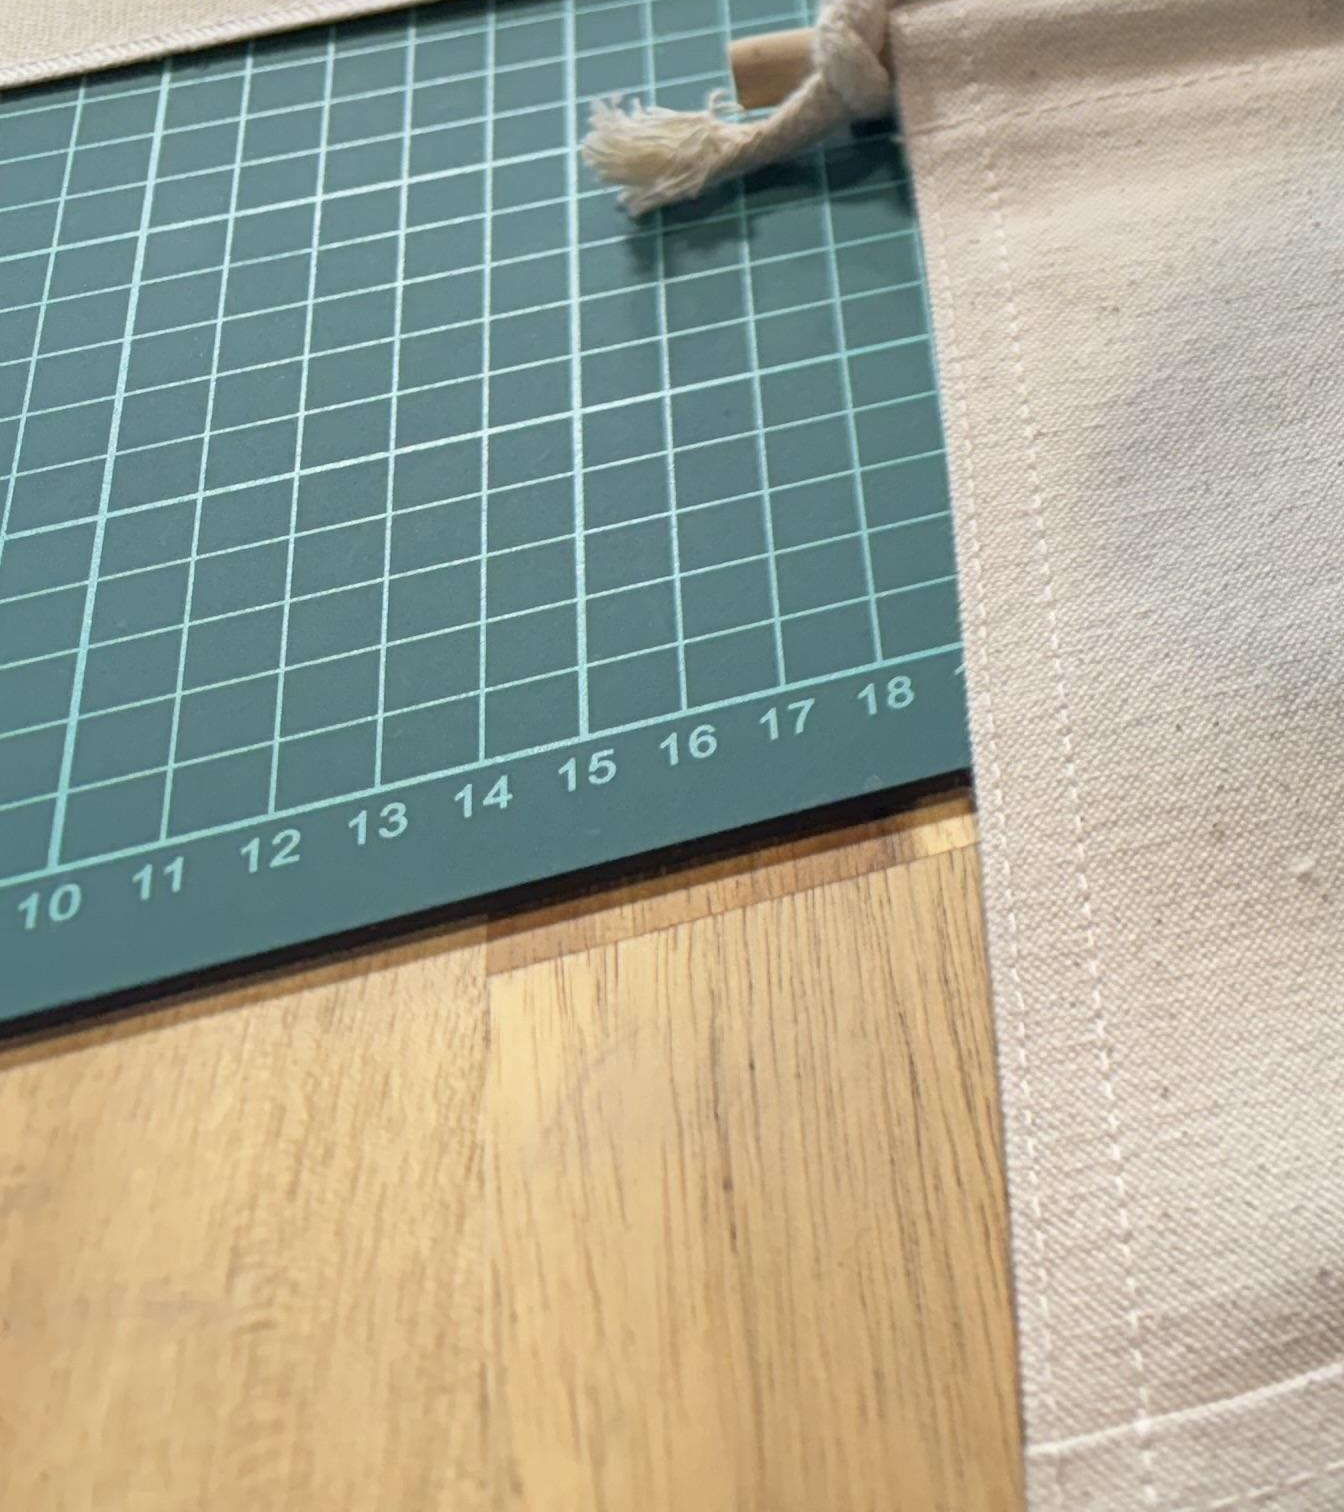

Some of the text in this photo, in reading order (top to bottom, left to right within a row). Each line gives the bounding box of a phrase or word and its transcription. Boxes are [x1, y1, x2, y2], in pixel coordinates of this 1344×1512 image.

[17, 674, 915, 931] 10 11 12 13 14 15 16 17 18
